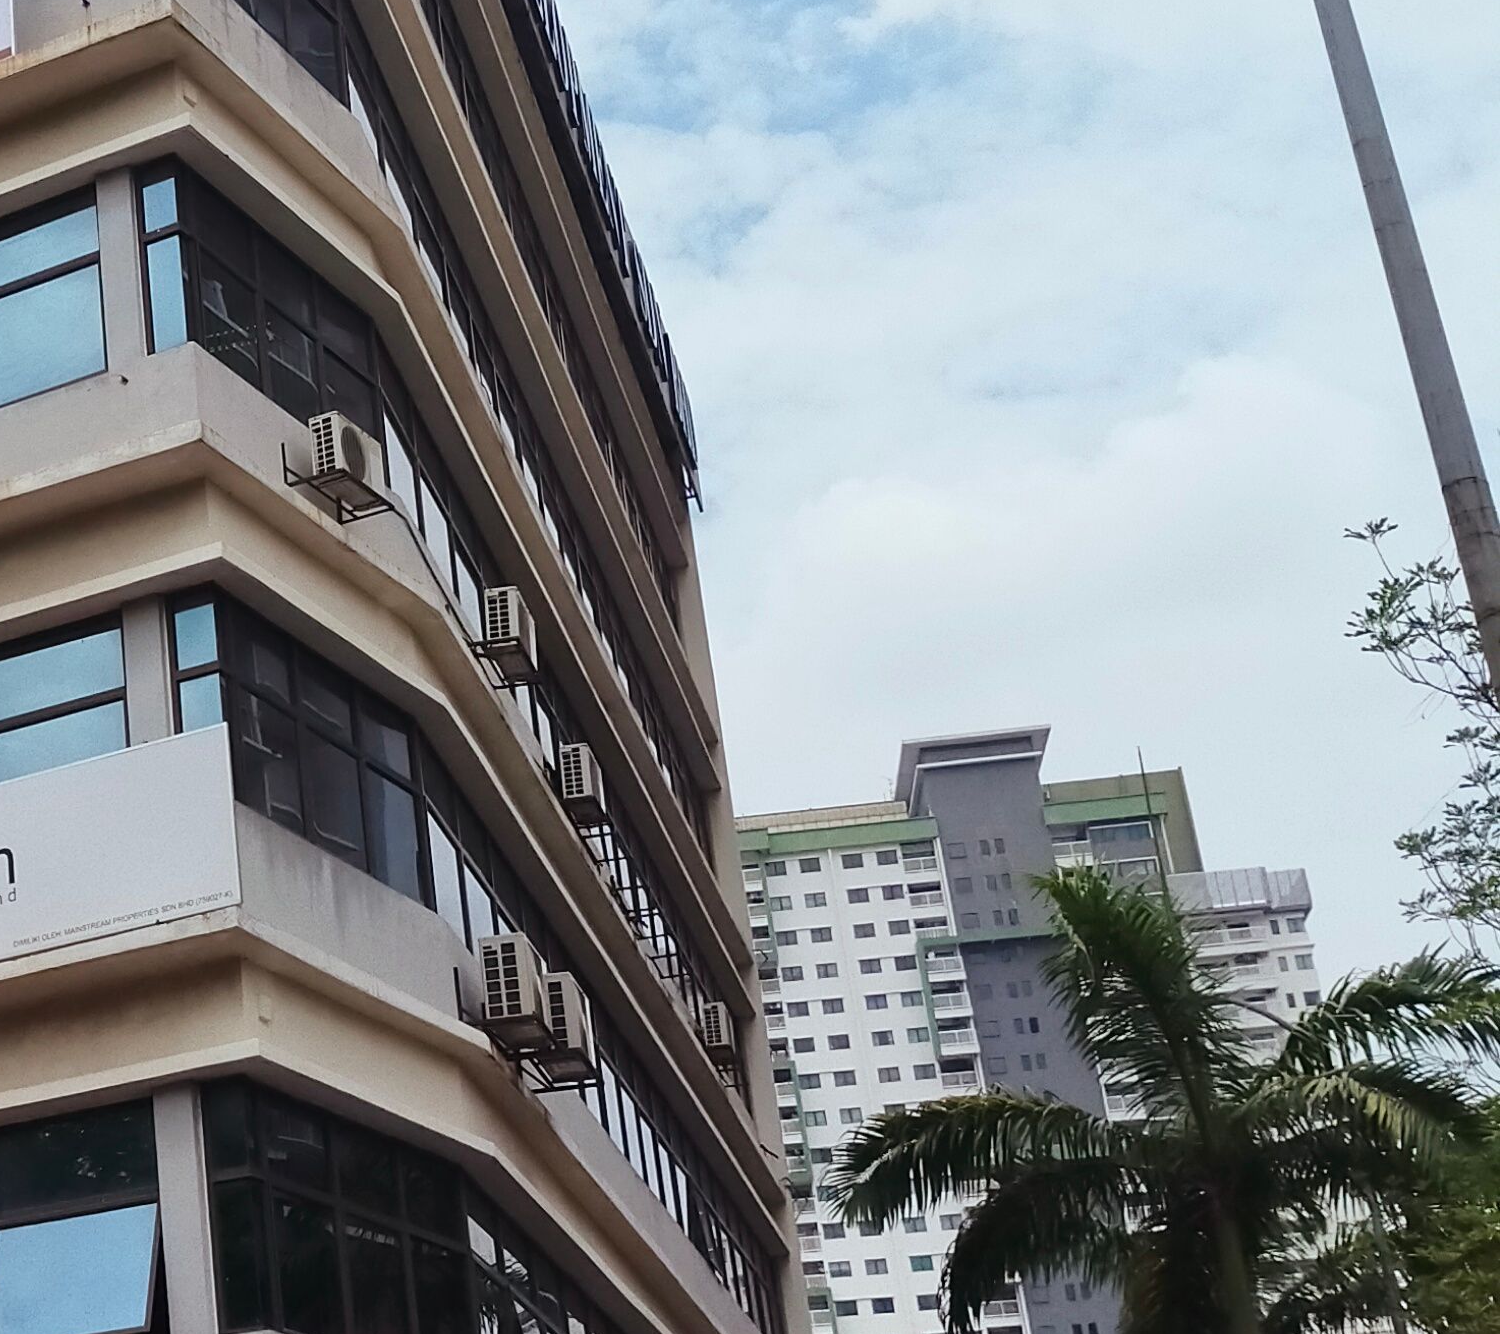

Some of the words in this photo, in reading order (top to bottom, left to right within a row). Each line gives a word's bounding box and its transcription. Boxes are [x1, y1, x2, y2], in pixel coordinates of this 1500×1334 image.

[64, 919, 112, 937] MAINSTREAM
[112, 906, 159, 926] PROPERTIES
[161, 902, 178, 915] SDN
[178, 898, 195, 910] BHD
